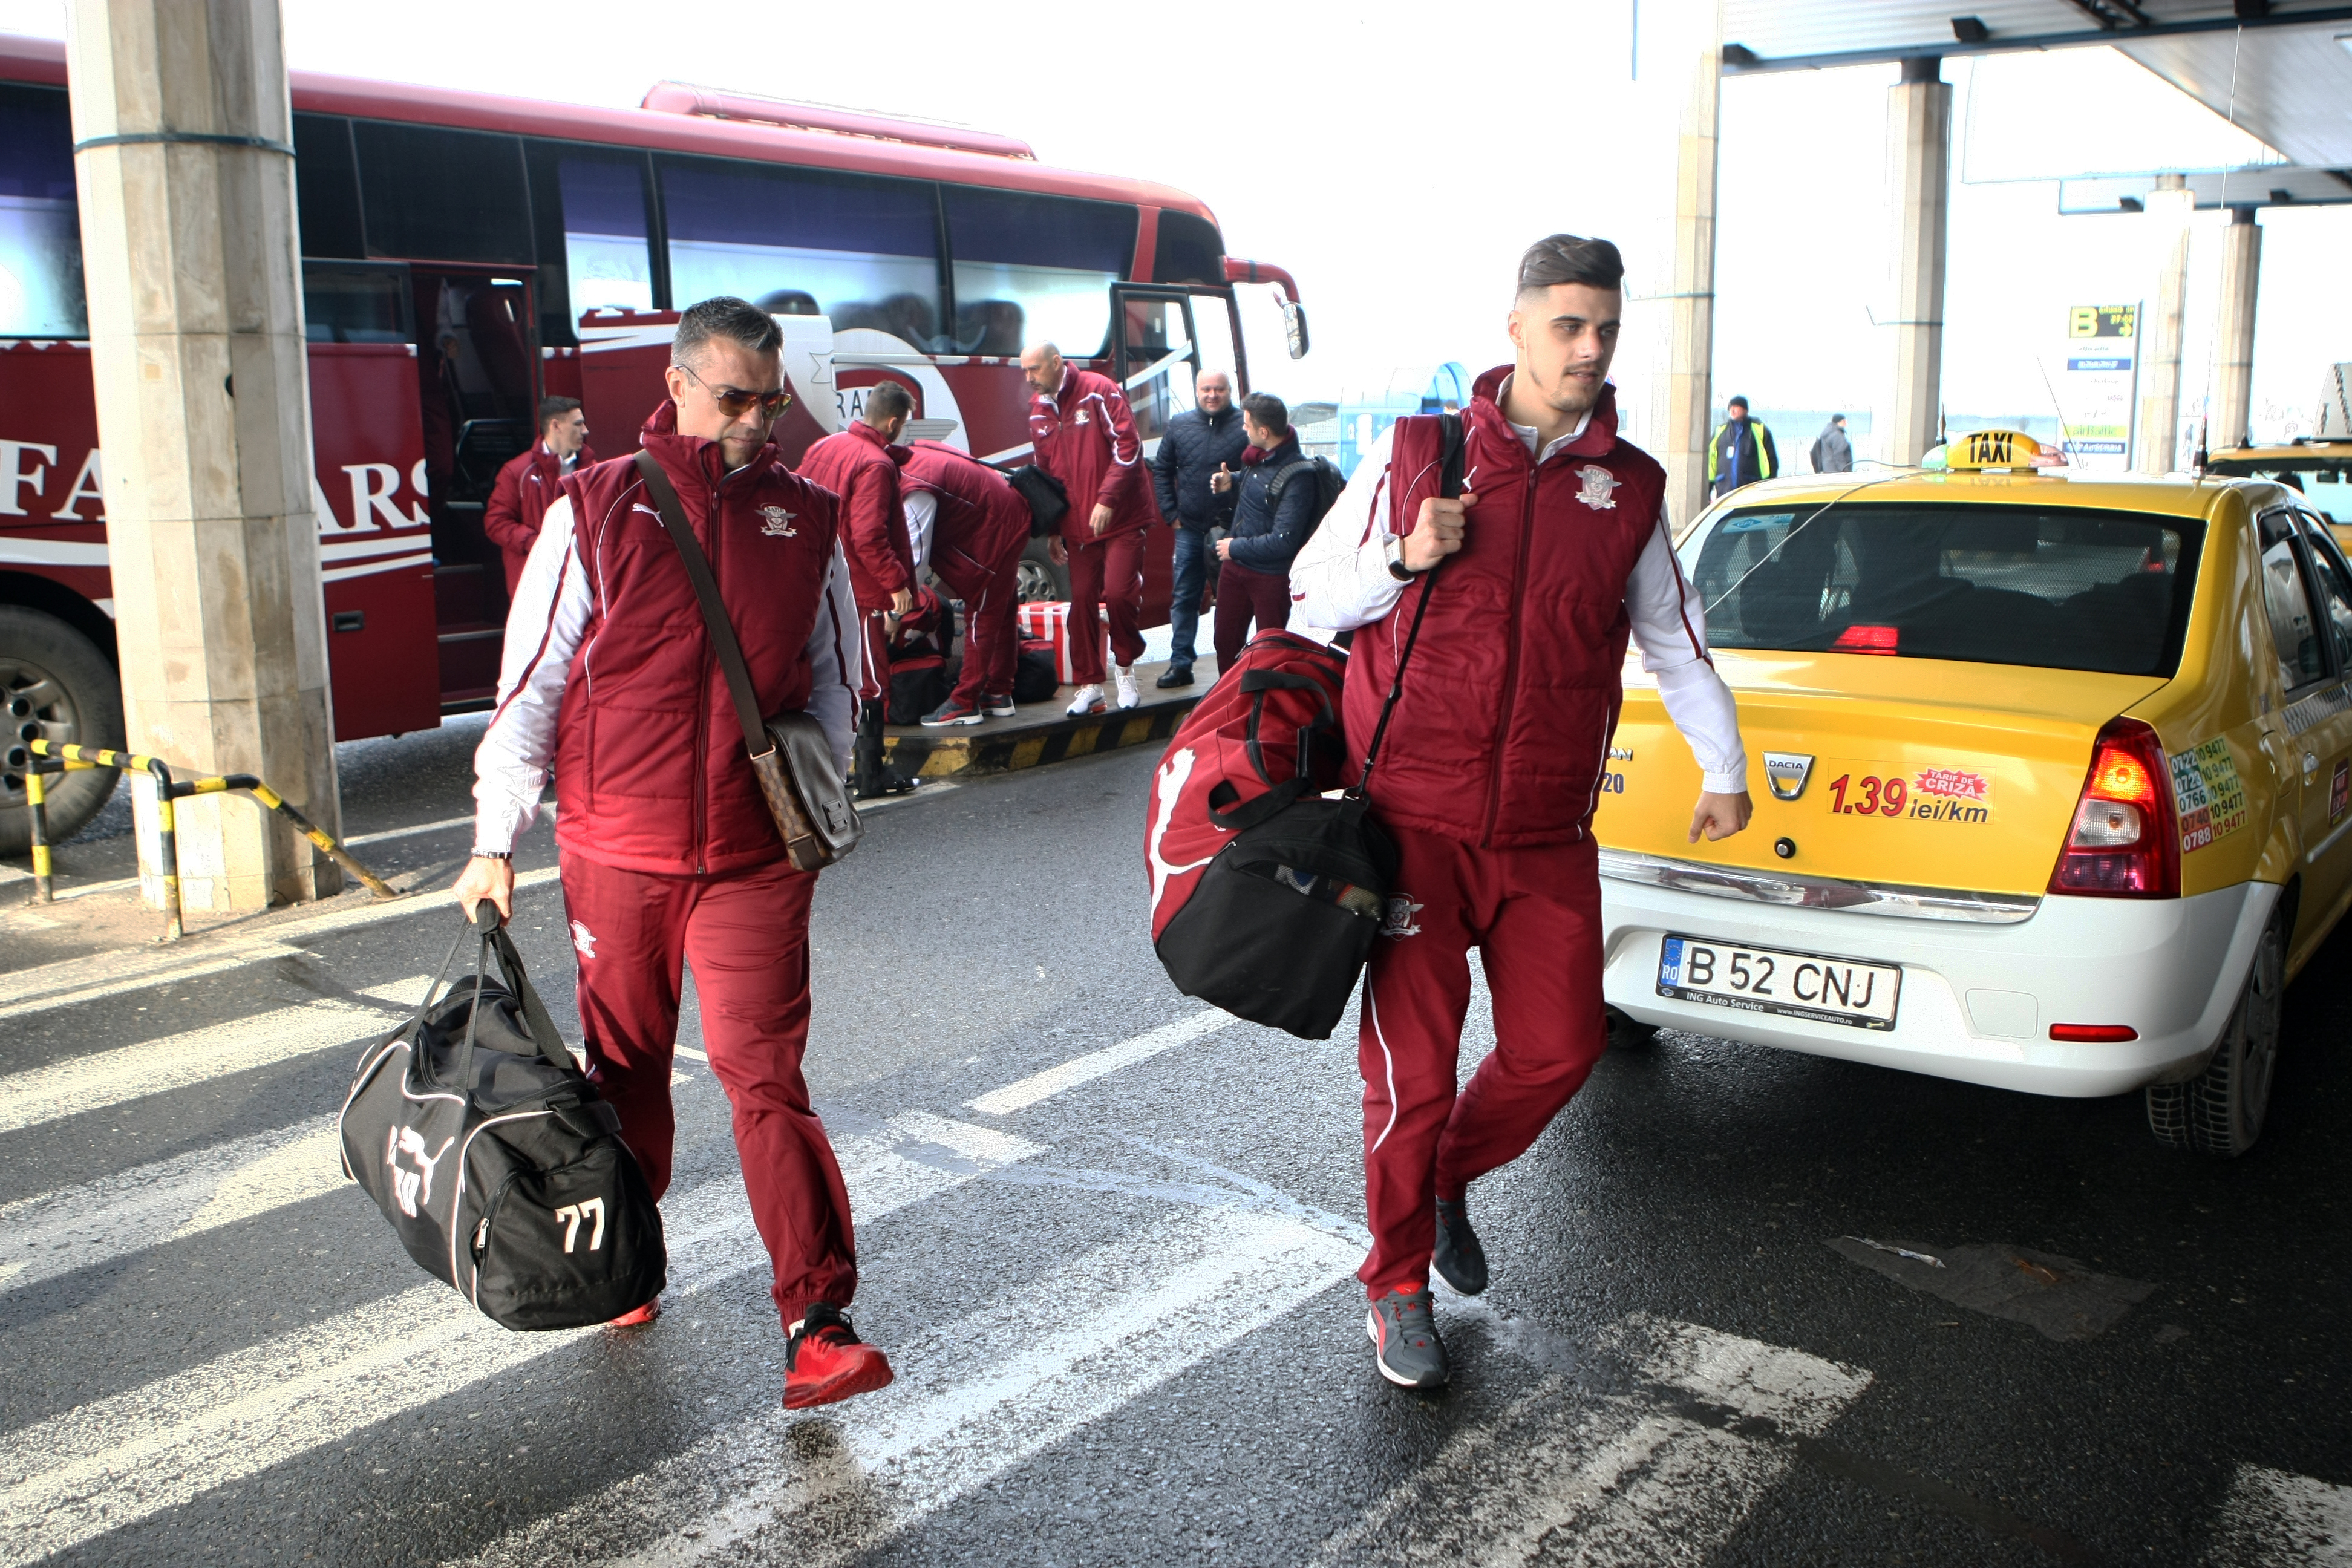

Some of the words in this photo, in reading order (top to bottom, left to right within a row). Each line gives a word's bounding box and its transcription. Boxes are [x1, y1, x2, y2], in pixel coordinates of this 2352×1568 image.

[2071, 307, 2098, 337] B
[836, 389, 873, 419] RA
[1967, 433, 2013, 463] TAXI
[1768, 760, 1804, 770] DACIA
[2171, 751, 2197, 773] 0722
[2205, 737, 2226, 758] 9477
[1926, 779, 1976, 797] CRIZA
[1930, 771, 1958, 783] TARIF
[1961, 777, 1974, 785] DE
[2175, 770, 2203, 794] 0723
[2212, 756, 2233, 777] 9477
[1829, 774, 1907, 817] 1.39
[1909, 799, 1988, 823] lei/km
[2179, 789, 2206, 812] 0766
[2218, 774, 2238, 796] 9477
[2181, 808, 2209, 832] 0740
[2221, 791, 2243, 814] 9477
[2183, 826, 2212, 851] 0788
[2224, 809, 2246, 832] 9477
[1662, 965, 1678, 981] RO
[1687, 946, 1716, 985] B
[1729, 952, 1775, 995] 52
[1793, 963, 1875, 1008] CNJ
[1687, 992, 1704, 1002] ING
[1706, 996, 1728, 1007] Auto
[1730, 999, 1764, 1012] Service
[1777, 1008, 1852, 1024] www.INGSERVICEAUTO.ro
[556, 1197, 605, 1253] 77
